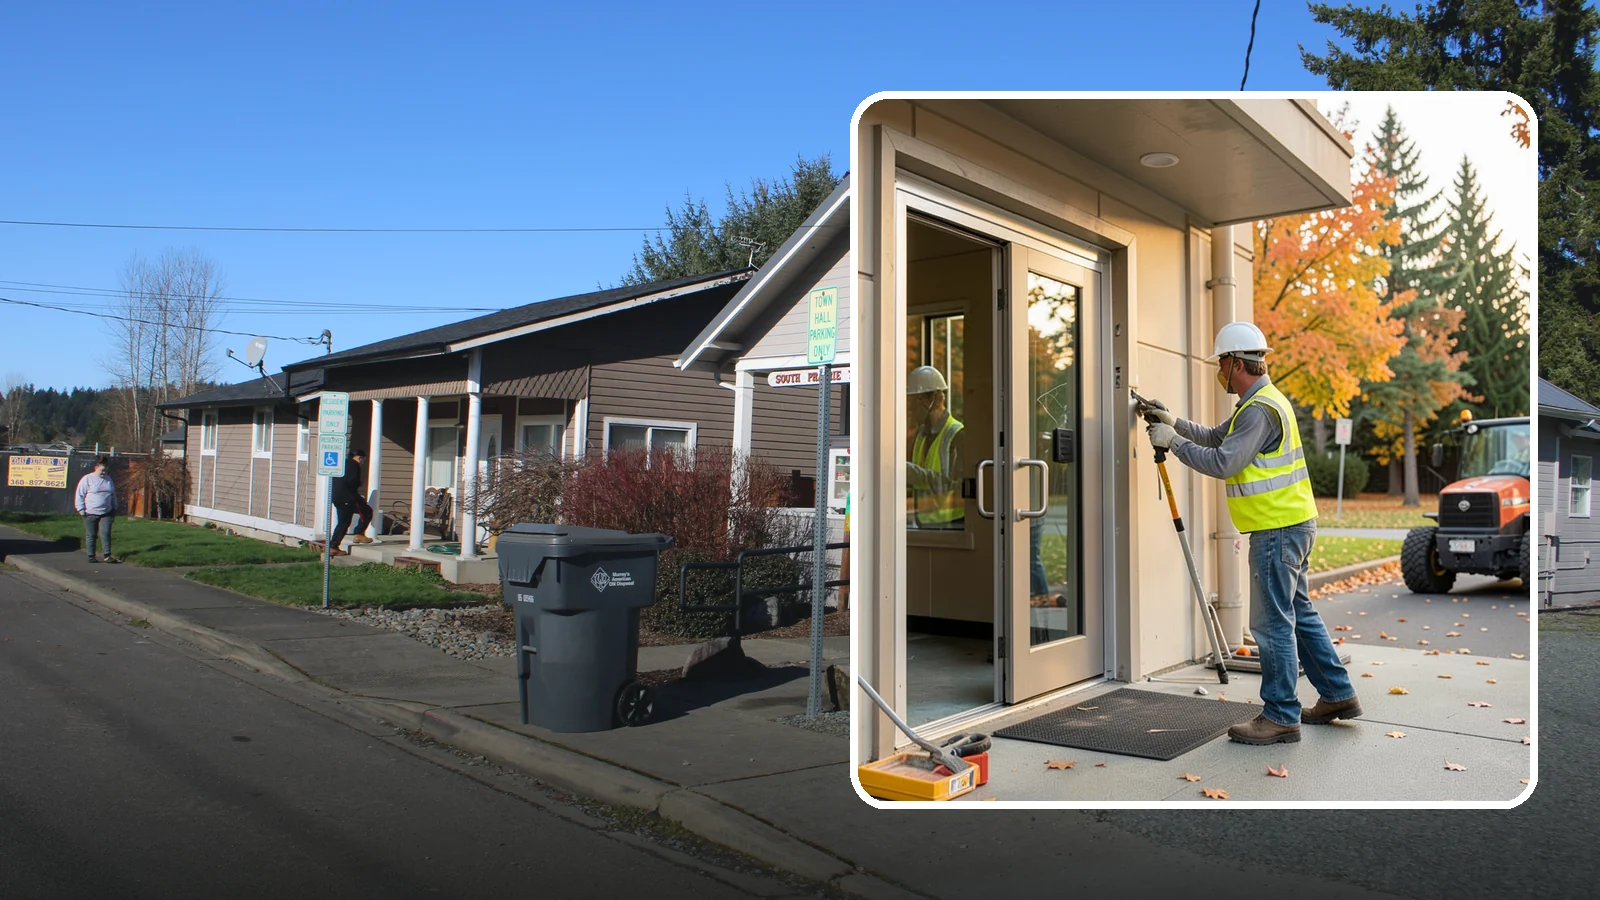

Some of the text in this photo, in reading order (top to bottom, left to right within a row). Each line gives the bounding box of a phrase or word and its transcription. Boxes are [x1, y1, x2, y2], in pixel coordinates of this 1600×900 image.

[815, 295, 833, 308] TOWN
[814, 312, 831, 325] HALL
[810, 327, 836, 341] PARKING
[813, 344, 831, 357] ONLY
[775, 373, 801, 384] SOUTH
